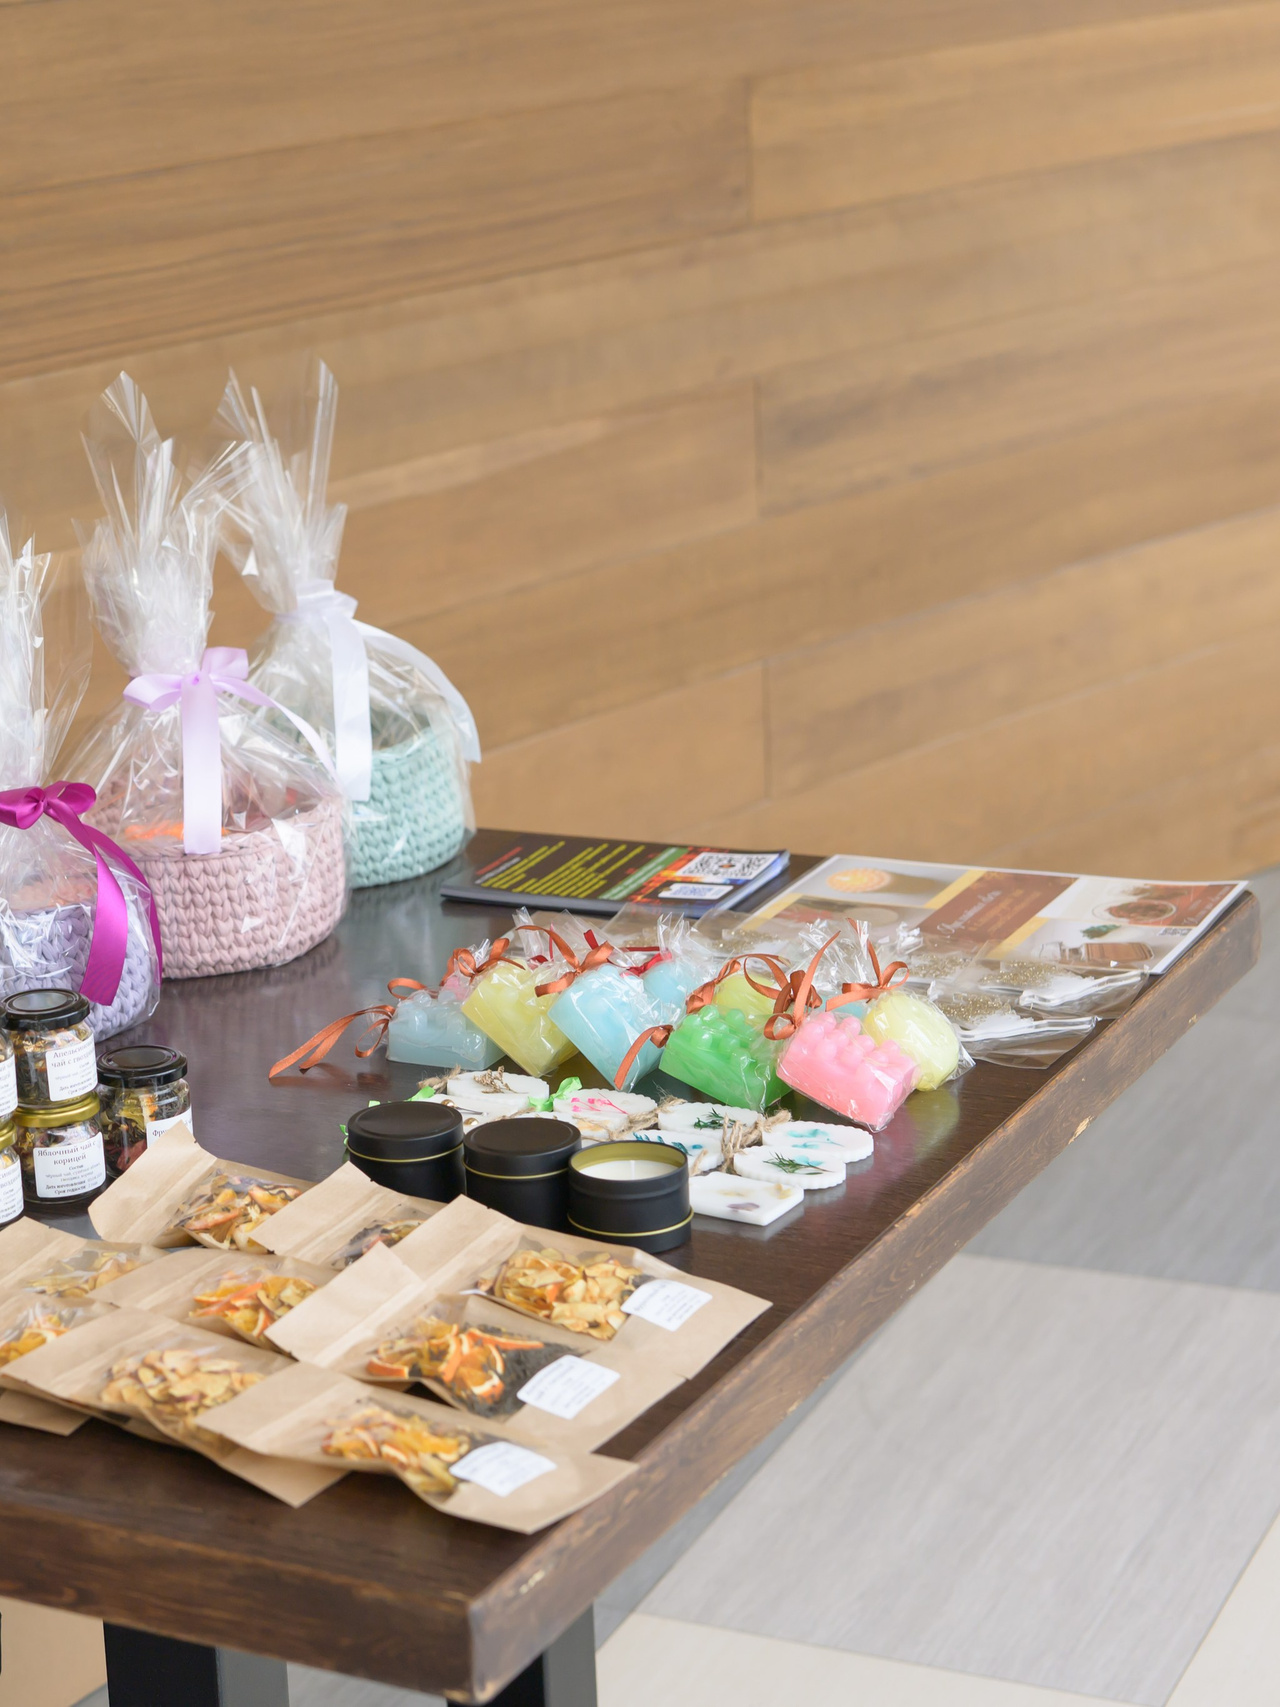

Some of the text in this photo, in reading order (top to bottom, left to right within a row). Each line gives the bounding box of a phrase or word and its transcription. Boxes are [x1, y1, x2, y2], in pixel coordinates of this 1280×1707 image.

[51, 1058, 66, 1068] чай
[38, 1146, 79, 1157] Яблочный
[80, 1141, 92, 1150] чай
[53, 1153, 87, 1166] корицей
